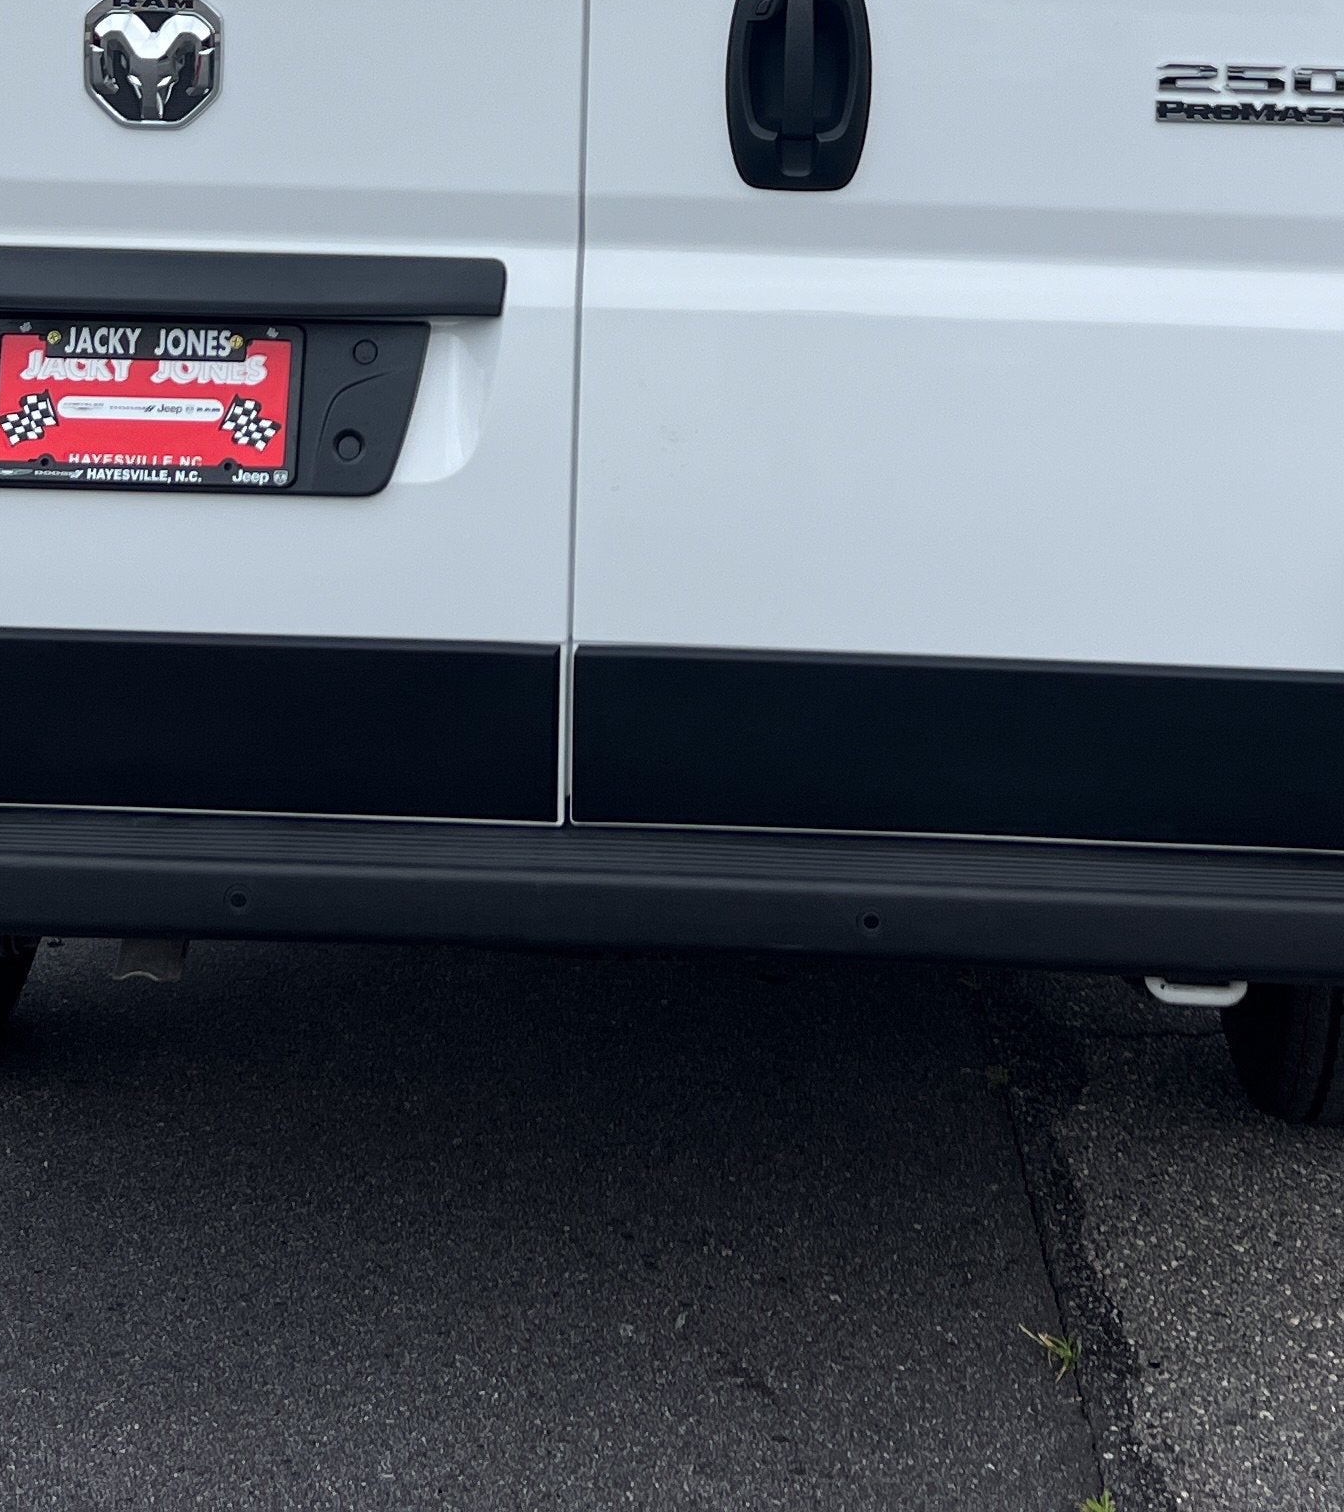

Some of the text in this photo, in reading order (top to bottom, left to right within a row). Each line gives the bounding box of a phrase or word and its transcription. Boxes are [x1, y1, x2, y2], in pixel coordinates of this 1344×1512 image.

[64, 325, 233, 357] JACKY JONES
[20, 349, 269, 386] JACKY JONES
[156, 403, 183, 414] Jeep
[86, 468, 172, 483] HAYESVILLE,
[175, 470, 202, 483] N.C.
[232, 469, 270, 485] Jeep
